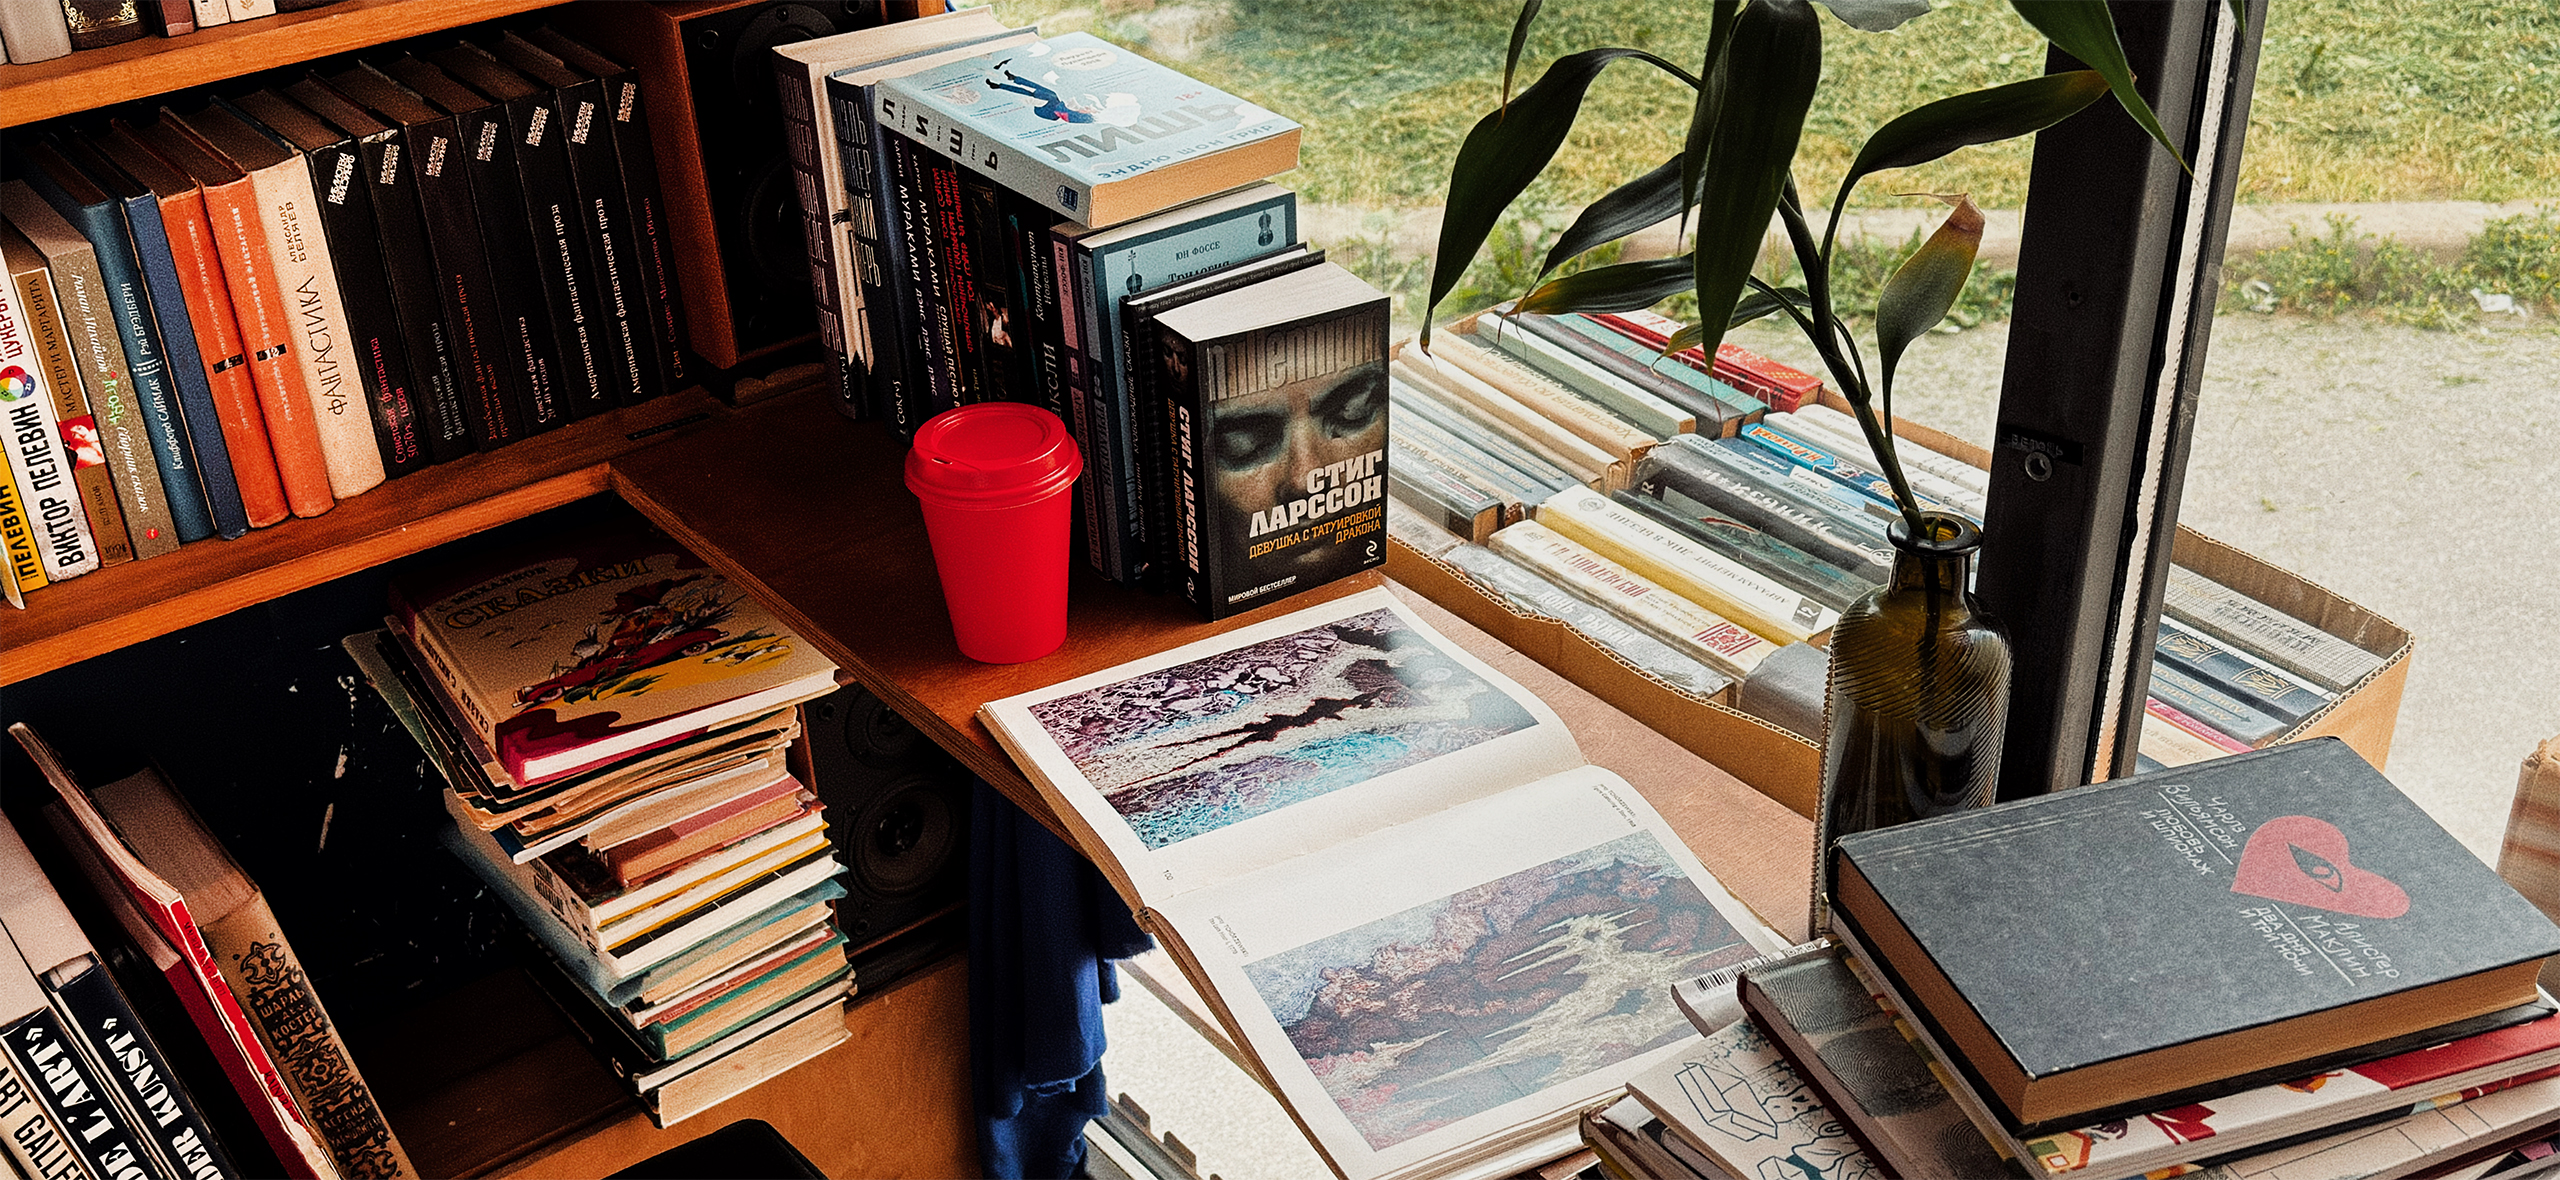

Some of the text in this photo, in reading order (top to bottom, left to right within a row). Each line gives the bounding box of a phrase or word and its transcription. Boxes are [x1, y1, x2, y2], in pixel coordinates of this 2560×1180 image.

[1175, 91, 1204, 102] 18+
[893, 139, 904, 178] ХАРУКИ
[1036, 103, 1246, 163] ЛИШЬ
[1097, 123, 1273, 179] ЭНДРЮ ШОН ГРИР
[278, 205, 298, 263] АЛЕКСАНДР
[285, 201, 306, 262] БЕЛЯЕВ
[898, 184, 921, 282] МУРАКАМИ
[911, 153, 942, 297] ХАРУКИ МУРАКАМИ
[1175, 241, 1221, 262] ЮН ФОССЕ
[551, 204, 601, 400] Американская фантастическая проза
[595, 198, 643, 394] Американская фантастическая проза
[1028, 231, 1045, 321] Контрапункт
[1041, 256, 1051, 305] Новеллы
[29, 278, 78, 414] МАСТЕР И МАРГАРИТА
[120, 282, 152, 356] Рэй БРЭДБЕРИ
[296, 275, 348, 415] ФАНТАСТИКА
[431, 322, 465, 436] фантастическая проза
[518, 316, 547, 423] Советская фантастика
[938, 305, 954, 354] СЛУШАЙ
[947, 350, 960, 399] ПЕСНЮ
[1122, 330, 1134, 372] СКАЗКИ
[1208, 310, 1383, 402] millennium
[149, 378, 186, 470] Клиффорд САЙМАК
[370, 337, 407, 463] Советская фантастика
[1554, 395, 1638, 440] Хрестоматия
[9, 402, 86, 568] ВИКТОР ПЕЛЕВИН
[1167, 397, 1178, 446] ДЕВУШКА
[1177, 517, 1186, 561] ДРАКОНА
[1179, 405, 1200, 574] СТИГ ЛАРССОН
[1306, 449, 1383, 495] СТИГ
[0, 485, 37, 577] ПЕЛЕВИН
[1249, 475, 1382, 539] ЛАРССОН
[1249, 504, 1382, 560] ДЕВУШКА С ТАТУИРОВКОЙ
[1335, 519, 1382, 545] ДРАКОНА
[1605, 510, 1655, 540] БЕЗДНЕ
[1564, 551, 1651, 598] ДАНИЛЕВСКИЙ
[1664, 538, 1693, 557] ЛИК
[1693, 556, 1741, 584] МЕРРИТ
[445, 557, 653, 630] СКАЗКИ
[1228, 575, 1297, 604] МИРОВОЙ БЕСТСЕЛЛЕР
[1736, 576, 1789, 604] АБРАХАМ
[1797, 602, 1822, 620] 12
[1537, 590, 1641, 647] КОНЬ РЫЖИЙ
[460, 688, 489, 735] СКАЗКИ
[2140, 810, 2215, 876] И ШПИОНАЖ
[2154, 808, 2205, 854] ЛЮБОВЬ
[2211, 796, 2247, 834] ЧАРЛЗ
[1162, 869, 1174, 881] 100
[2239, 908, 2314, 977] И ТРИ НОЧИ
[2254, 906, 2313, 957] ДВА ДНЯ
[2300, 915, 2371, 979] МАКЛИН
[260, 989, 305, 1019] ШАРЛЬ
[271, 1006, 318, 1042] КОСТЕР
[322, 1099, 372, 1129] ЛЕГЕНДА
